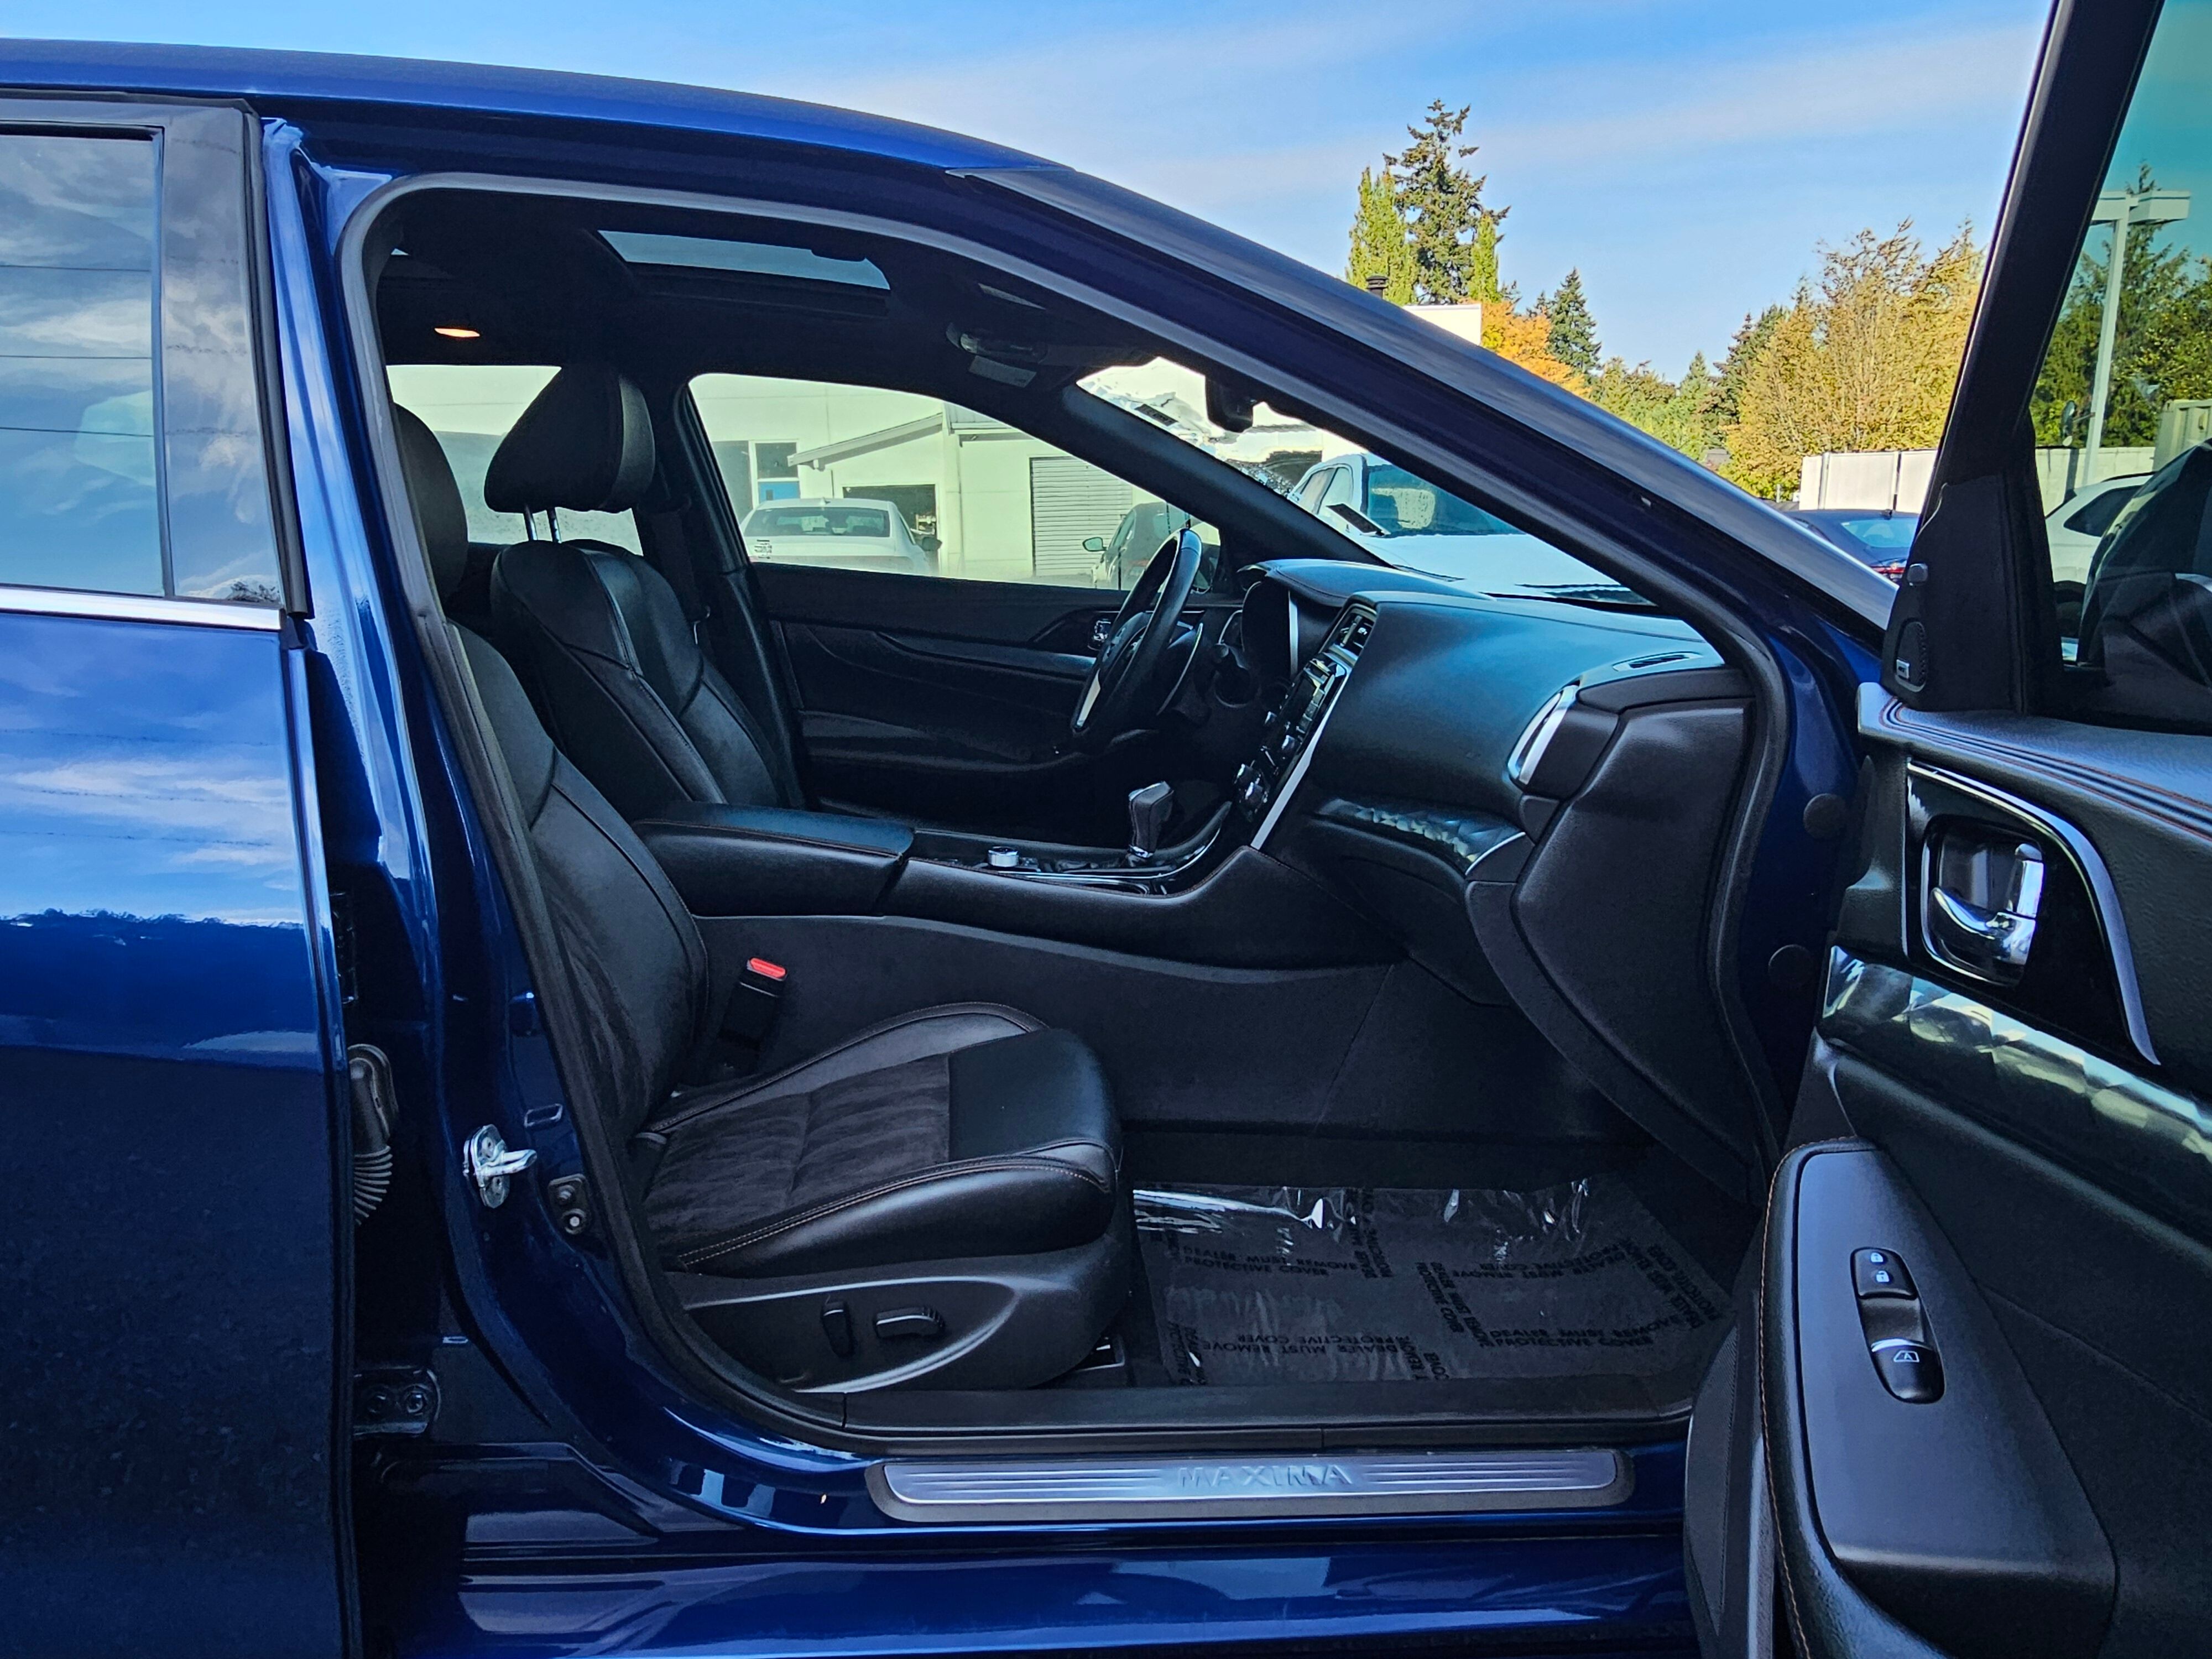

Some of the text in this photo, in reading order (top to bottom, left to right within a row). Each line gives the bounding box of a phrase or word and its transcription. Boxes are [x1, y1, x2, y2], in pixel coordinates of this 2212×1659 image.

[1183, 1245, 1237, 1261] DEALER
[1246, 1255, 1287, 1265] MUST
[1296, 1258, 1358, 1271] REMOVE
[1184, 1255, 1329, 1277] PROTECTIVE COVER
[1489, 1314, 1683, 1339] DEALER MUST REMOVE
[1201, 1341, 1398, 1355] DEALER MUST REMOVE
[1237, 1334, 1394, 1344] PROTECTIVE COVER
[1494, 1335, 1653, 1347] PROTECTIVE COVER
[1177, 1464, 1353, 1488] MAXIMA
